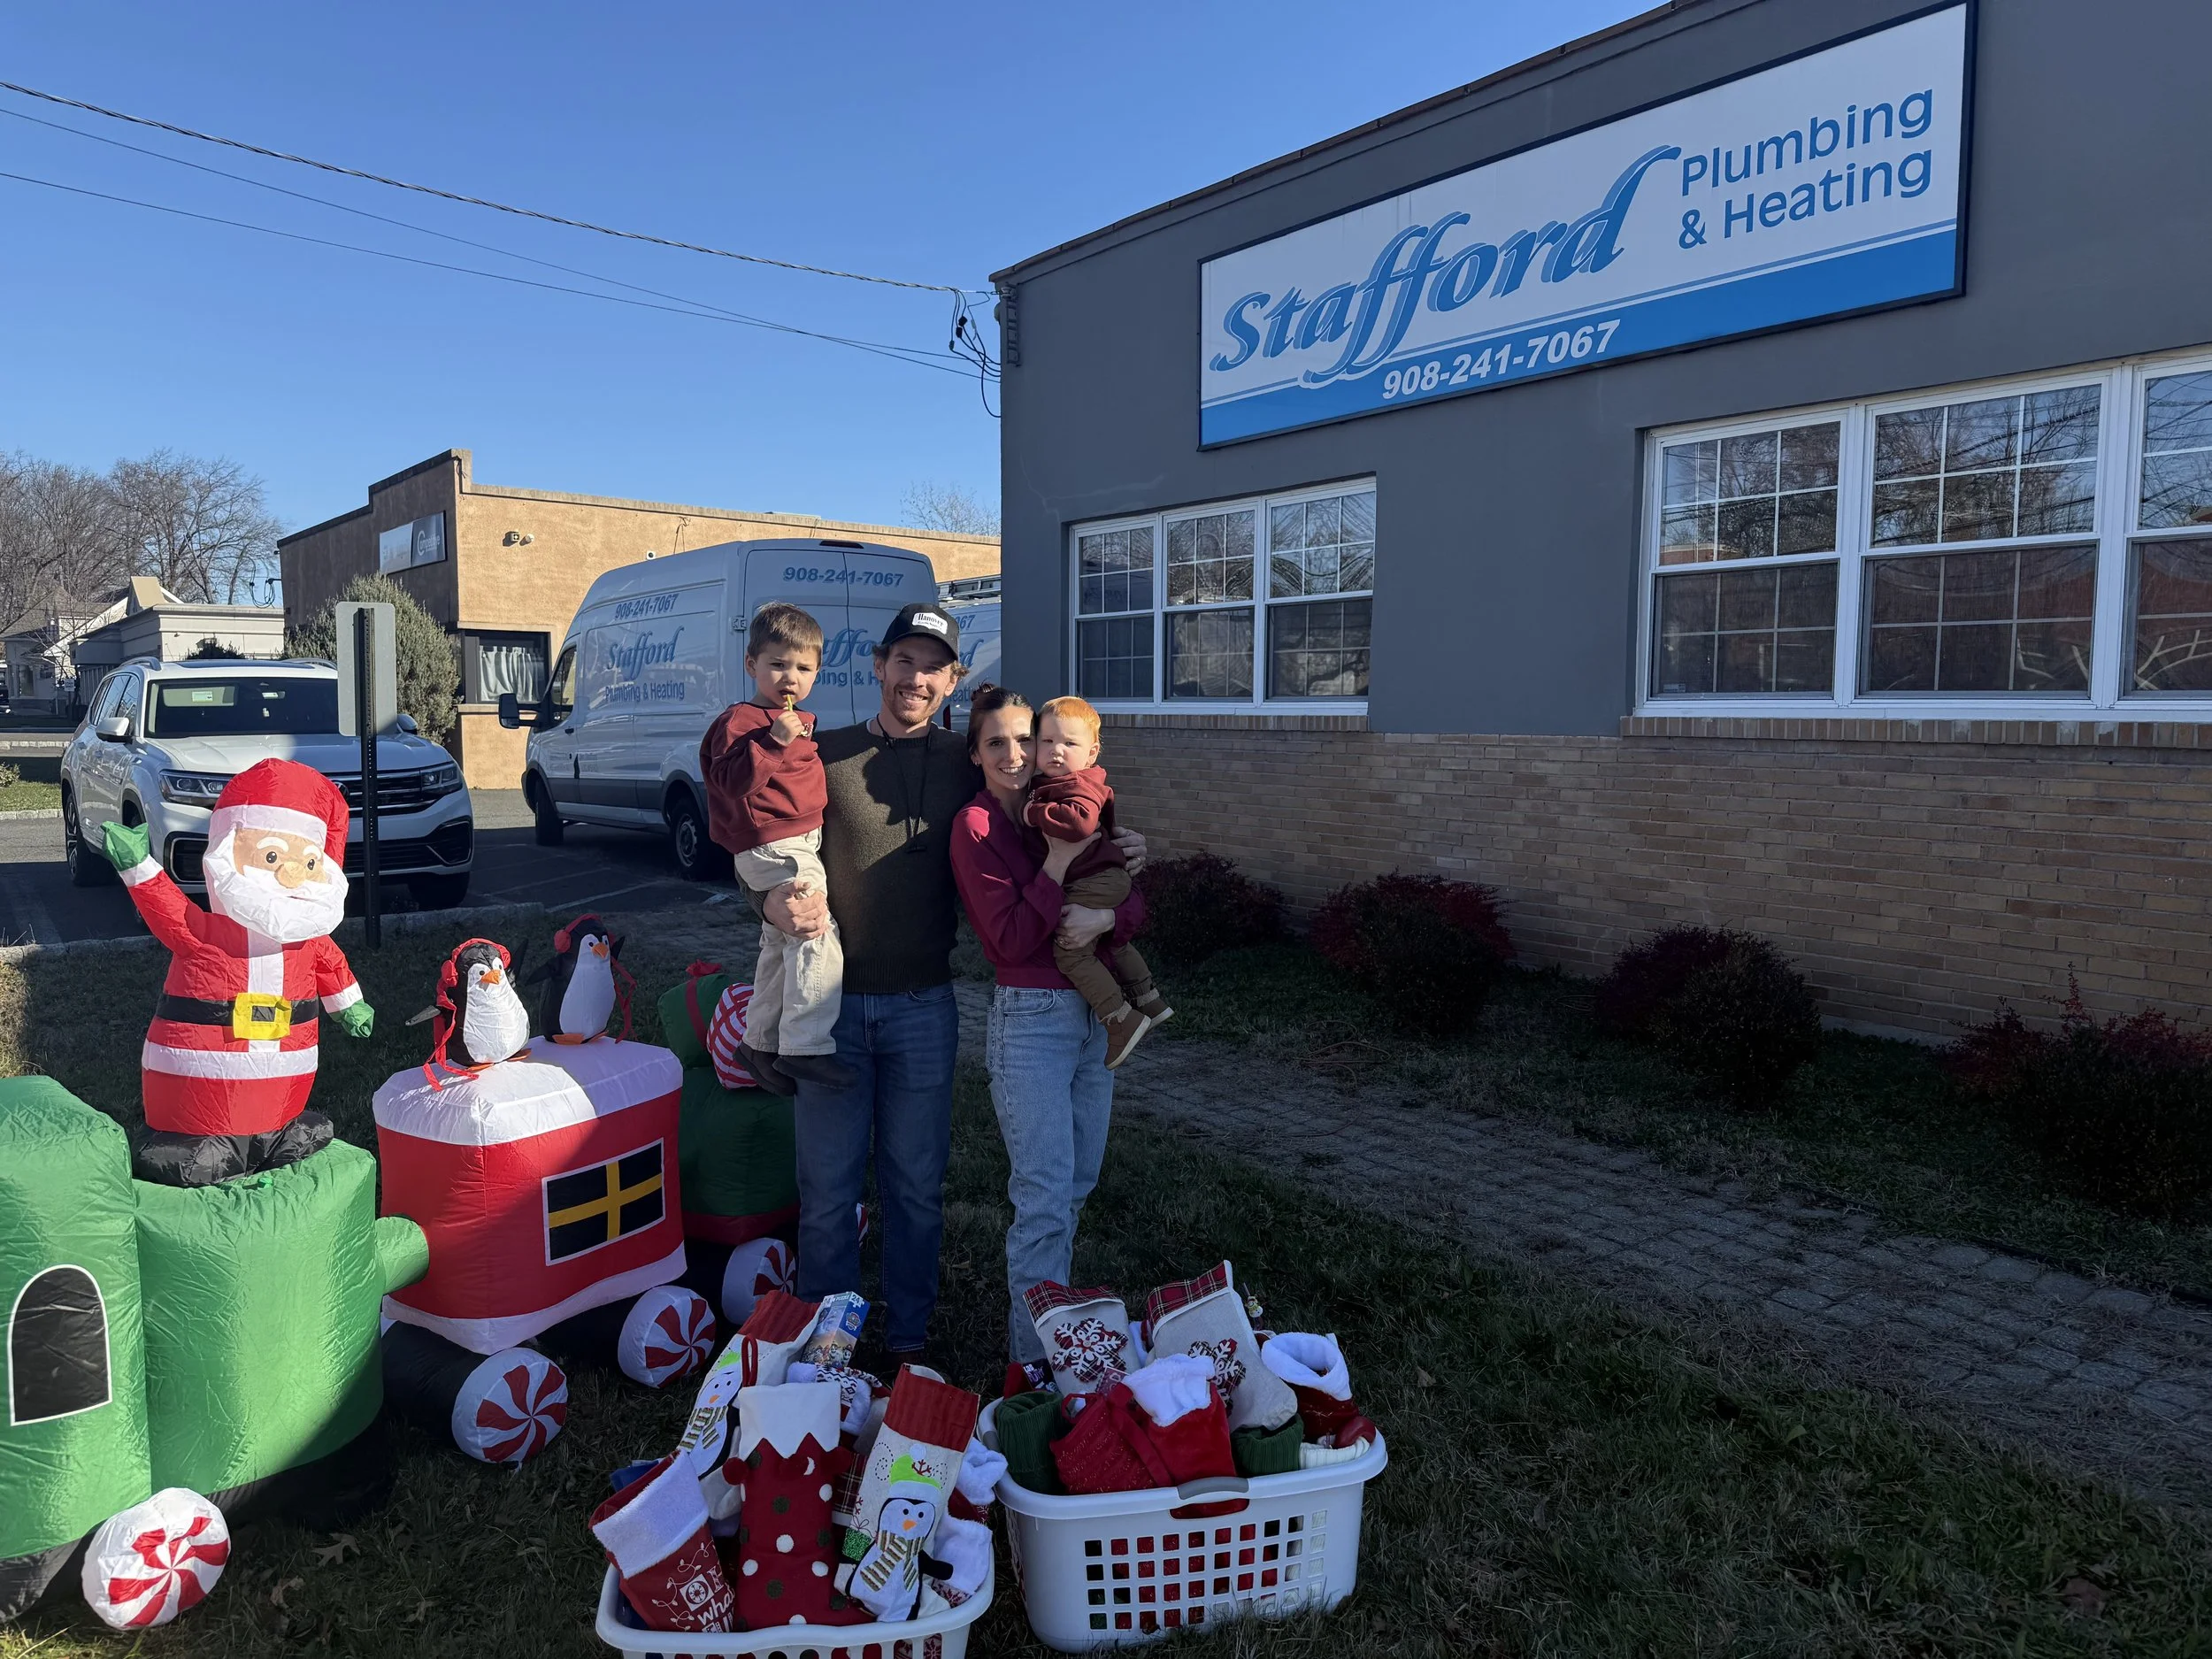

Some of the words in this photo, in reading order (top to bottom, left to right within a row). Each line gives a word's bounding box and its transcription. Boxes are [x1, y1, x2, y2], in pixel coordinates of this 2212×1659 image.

[1682, 88, 1932, 196] Plumbing
[1678, 208, 1708, 250] &
[1724, 149, 1932, 239] Heating
[1209, 144, 1682, 384] Stafford
[1382, 319, 1622, 400] 908-241-7067
[615, 593, 680, 619] 908-241-7067
[783, 566, 904, 587] 908-241-7067
[606, 625, 685, 682] Stafford
[605, 686, 641, 703] Plumbing
[650, 680, 685, 702] Heating
